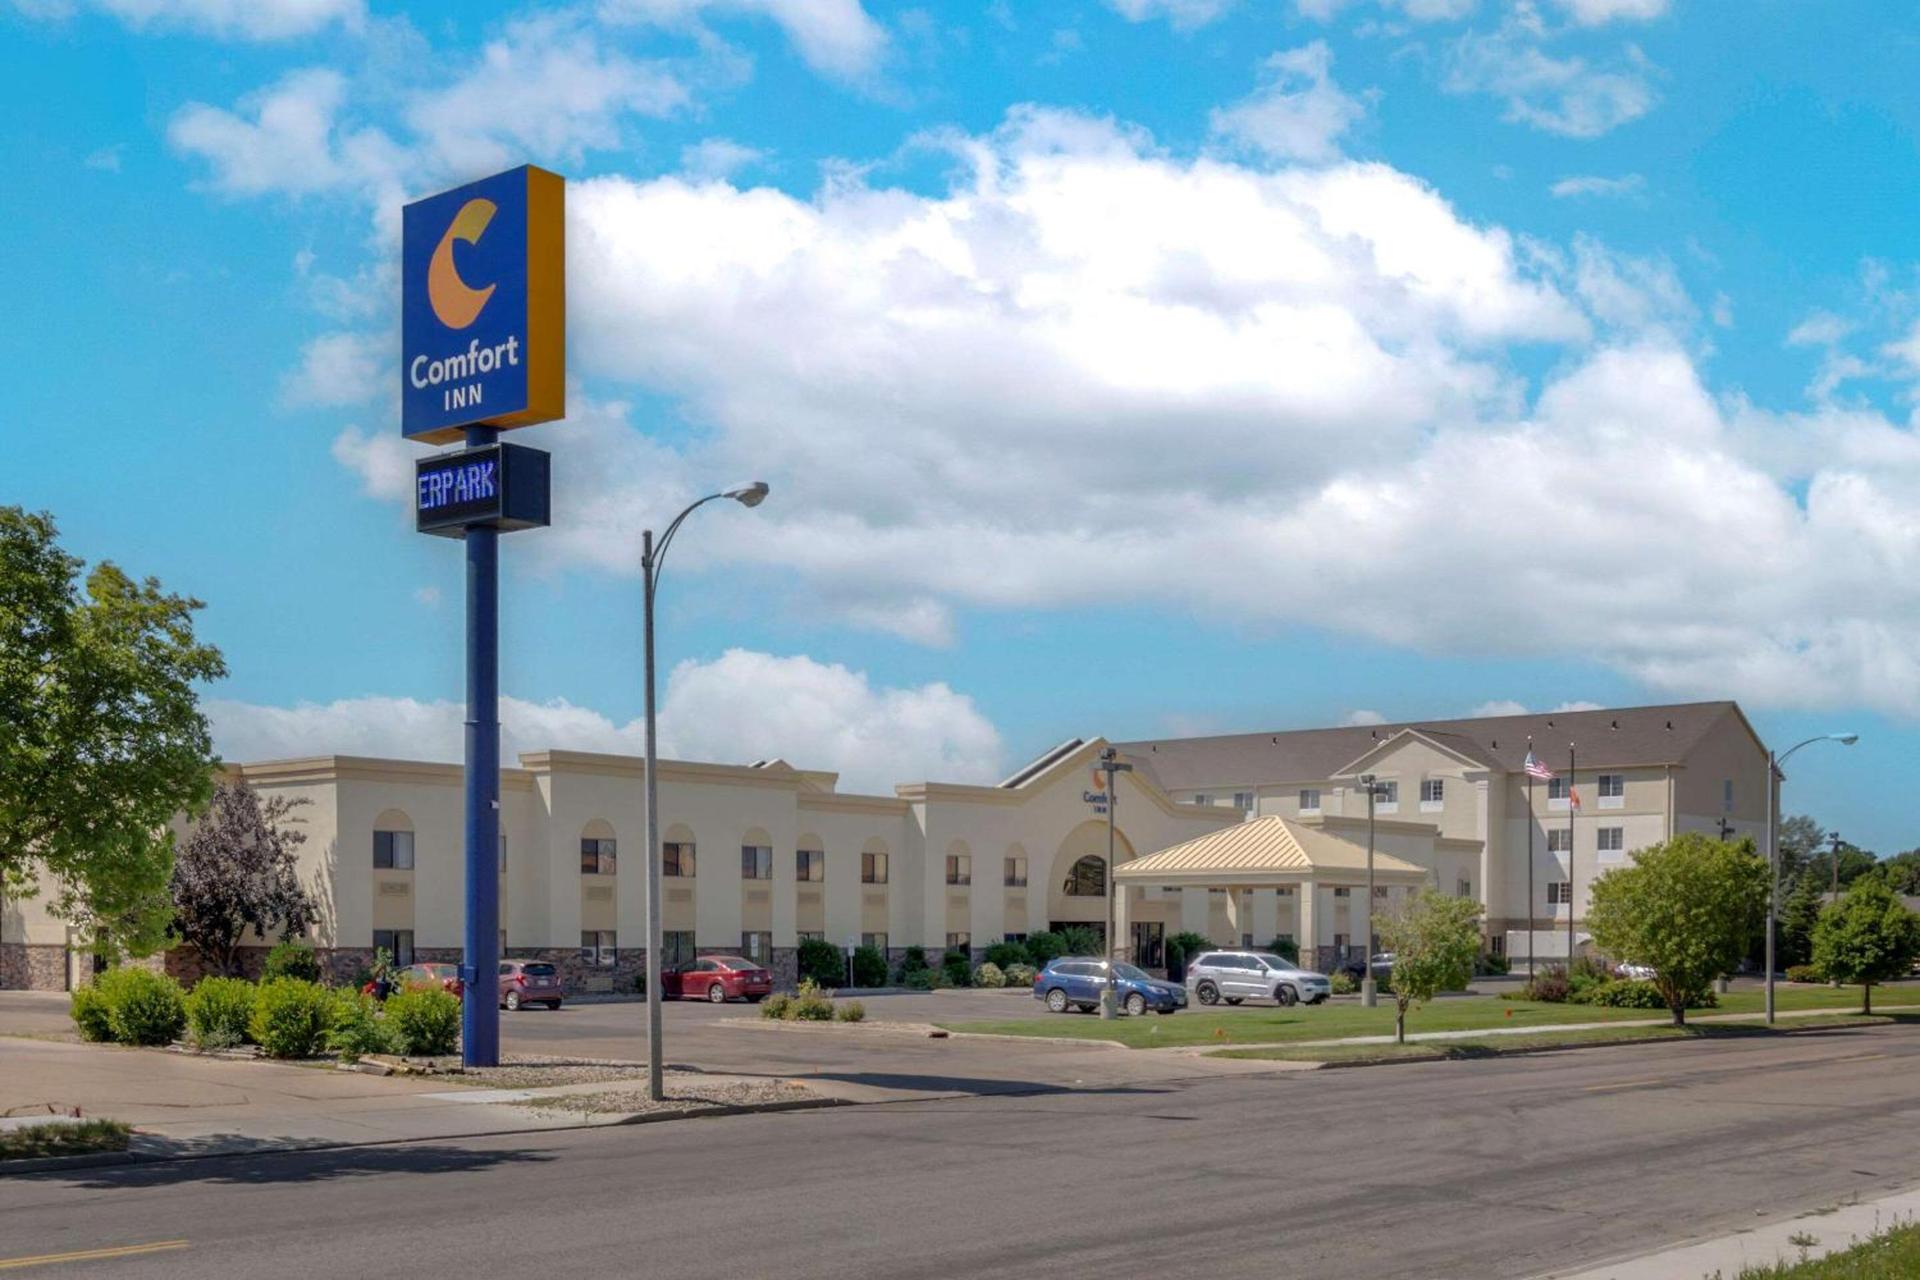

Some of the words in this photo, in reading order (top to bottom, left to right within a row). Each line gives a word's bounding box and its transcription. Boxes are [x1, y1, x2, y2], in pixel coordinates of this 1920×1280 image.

[410, 335, 519, 389] Comfort
[444, 383, 482, 411] INN
[417, 462, 495, 510] ERPARK
